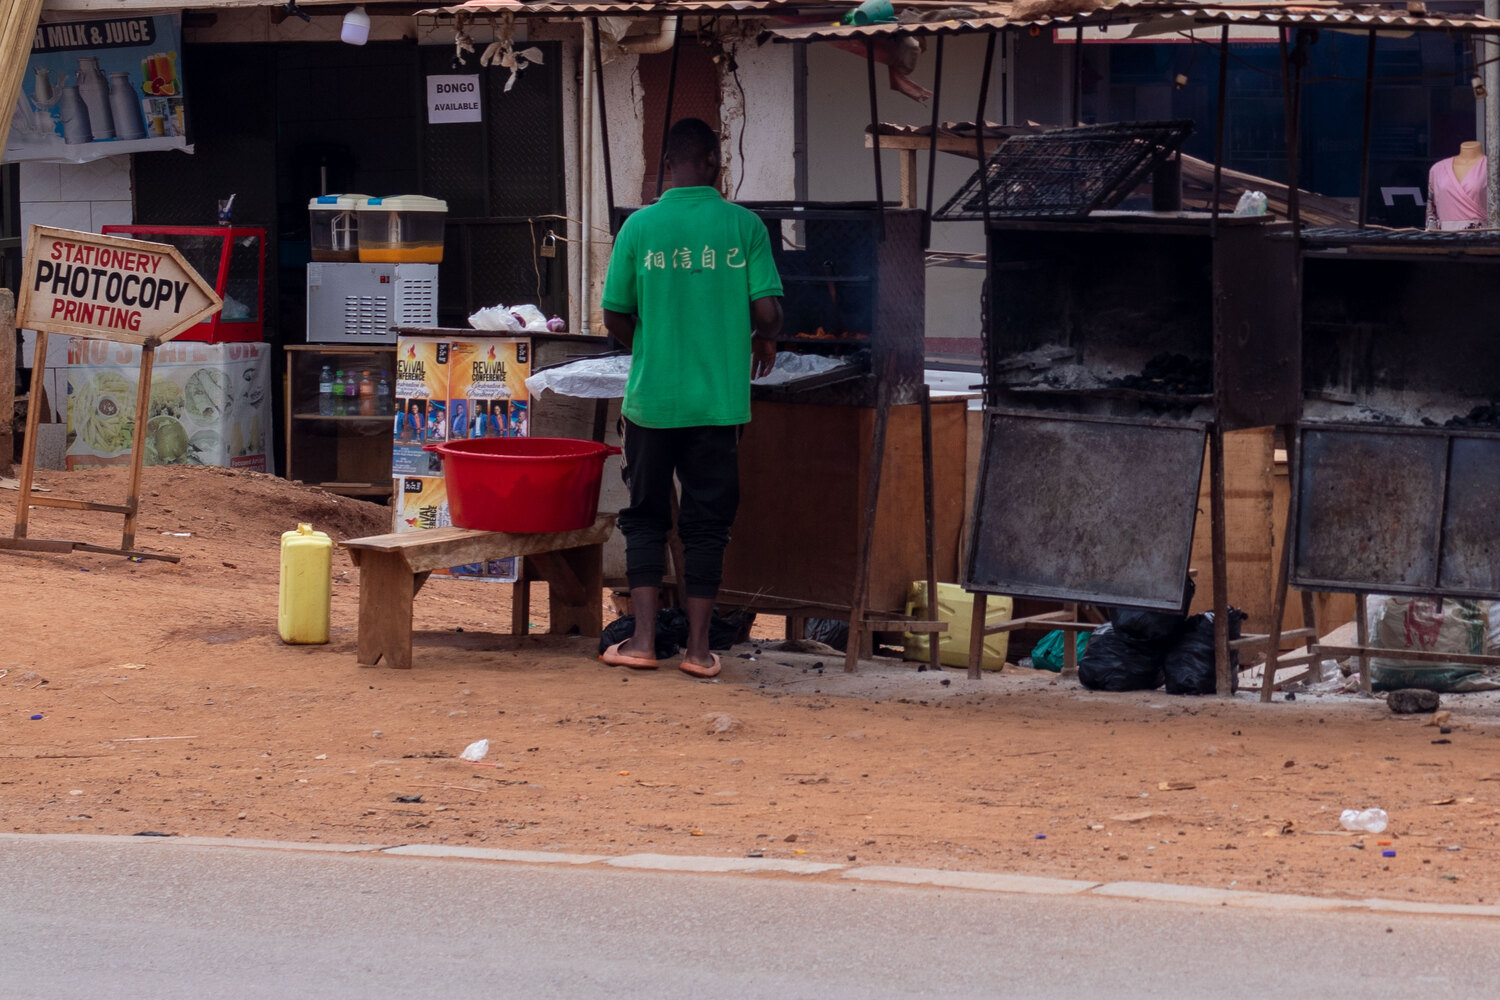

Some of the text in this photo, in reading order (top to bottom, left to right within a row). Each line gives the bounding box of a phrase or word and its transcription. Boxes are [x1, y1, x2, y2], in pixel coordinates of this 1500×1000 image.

[47, 24, 88, 47] MILK
[90, 27, 103, 44] &
[105, 20, 150, 43] JUICE
[436, 83, 474, 93] BONGO
[434, 102, 479, 111] AVAILABLE
[51, 241, 162, 274] STATIONERY
[34, 260, 189, 313] PHOTOCOPY
[51, 298, 142, 331] PRINTING
[397, 360, 425, 373] EVIVAL
[473, 361, 506, 373] REVIVAL
[472, 373, 506, 381] CONFERENCE
